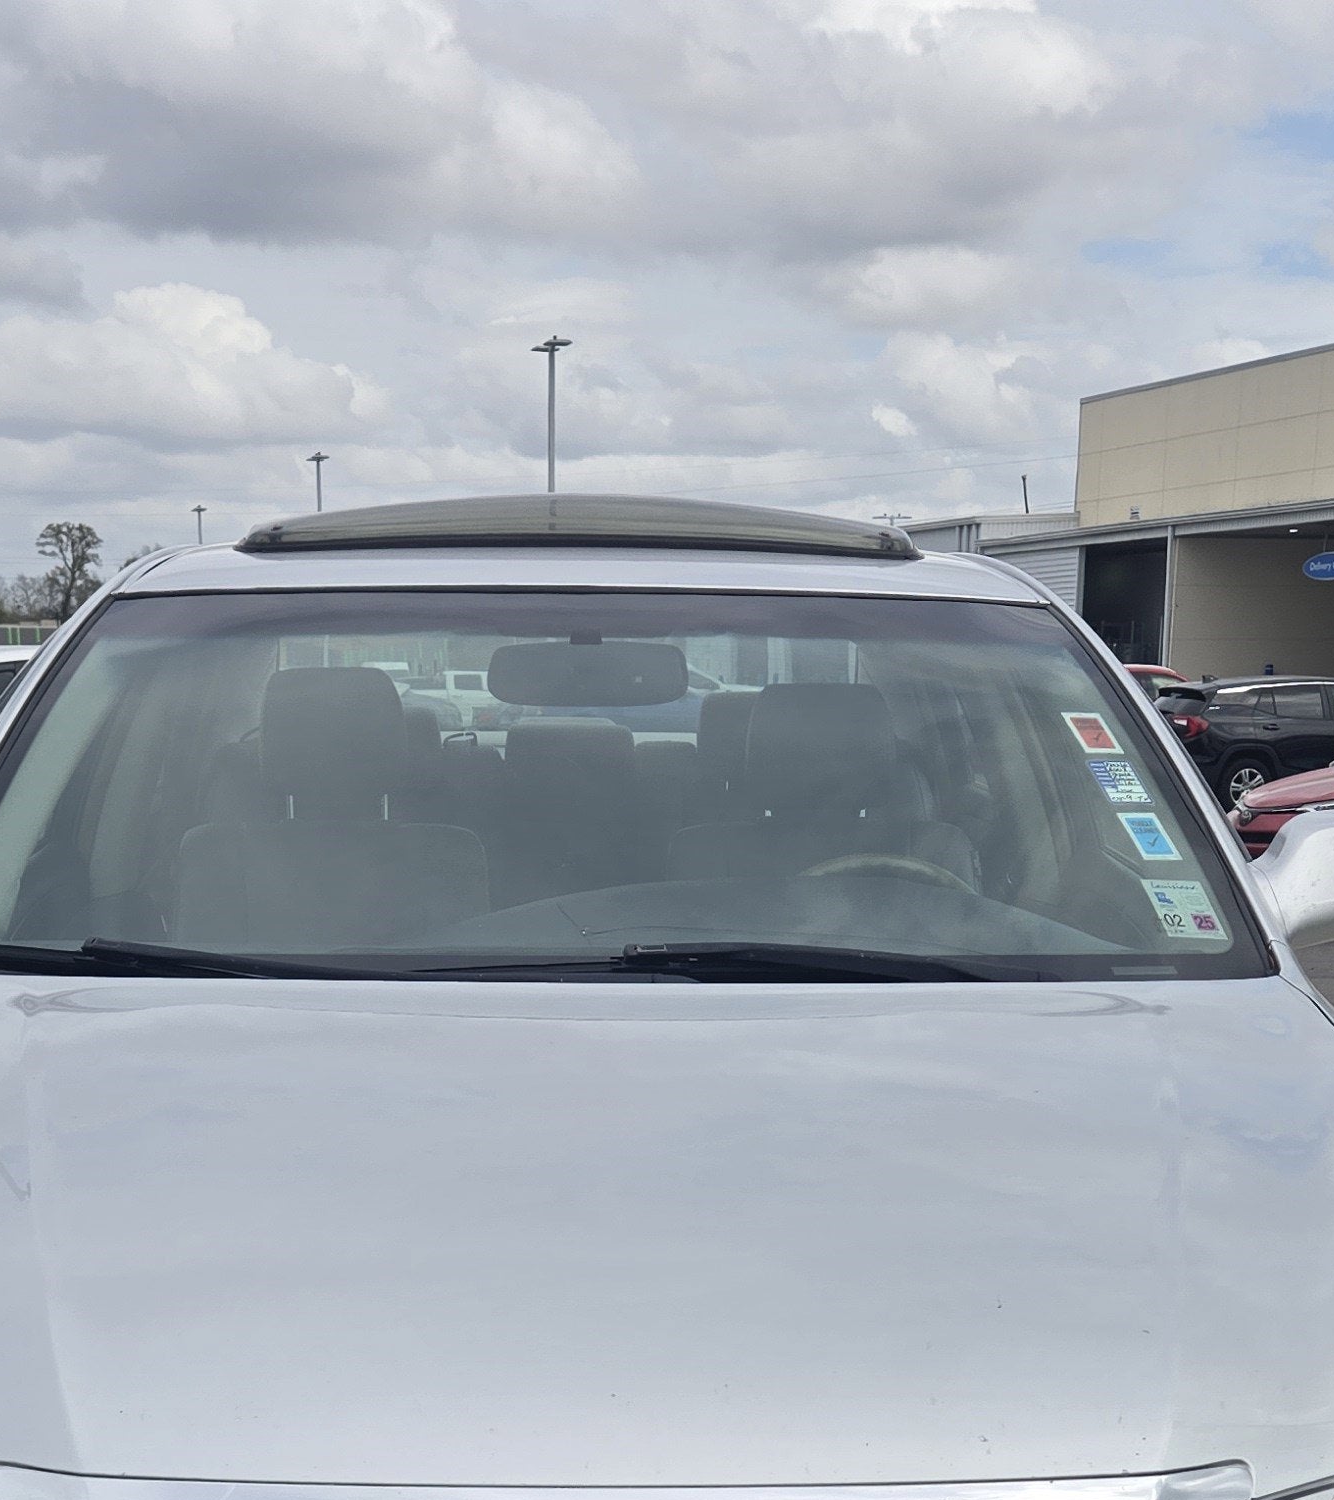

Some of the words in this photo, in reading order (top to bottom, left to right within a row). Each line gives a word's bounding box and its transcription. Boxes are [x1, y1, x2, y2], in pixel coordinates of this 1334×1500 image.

[1309, 561, 1331, 572] Delivery
[1163, 913, 1187, 928] 02
[1193, 914, 1217, 931] 25
